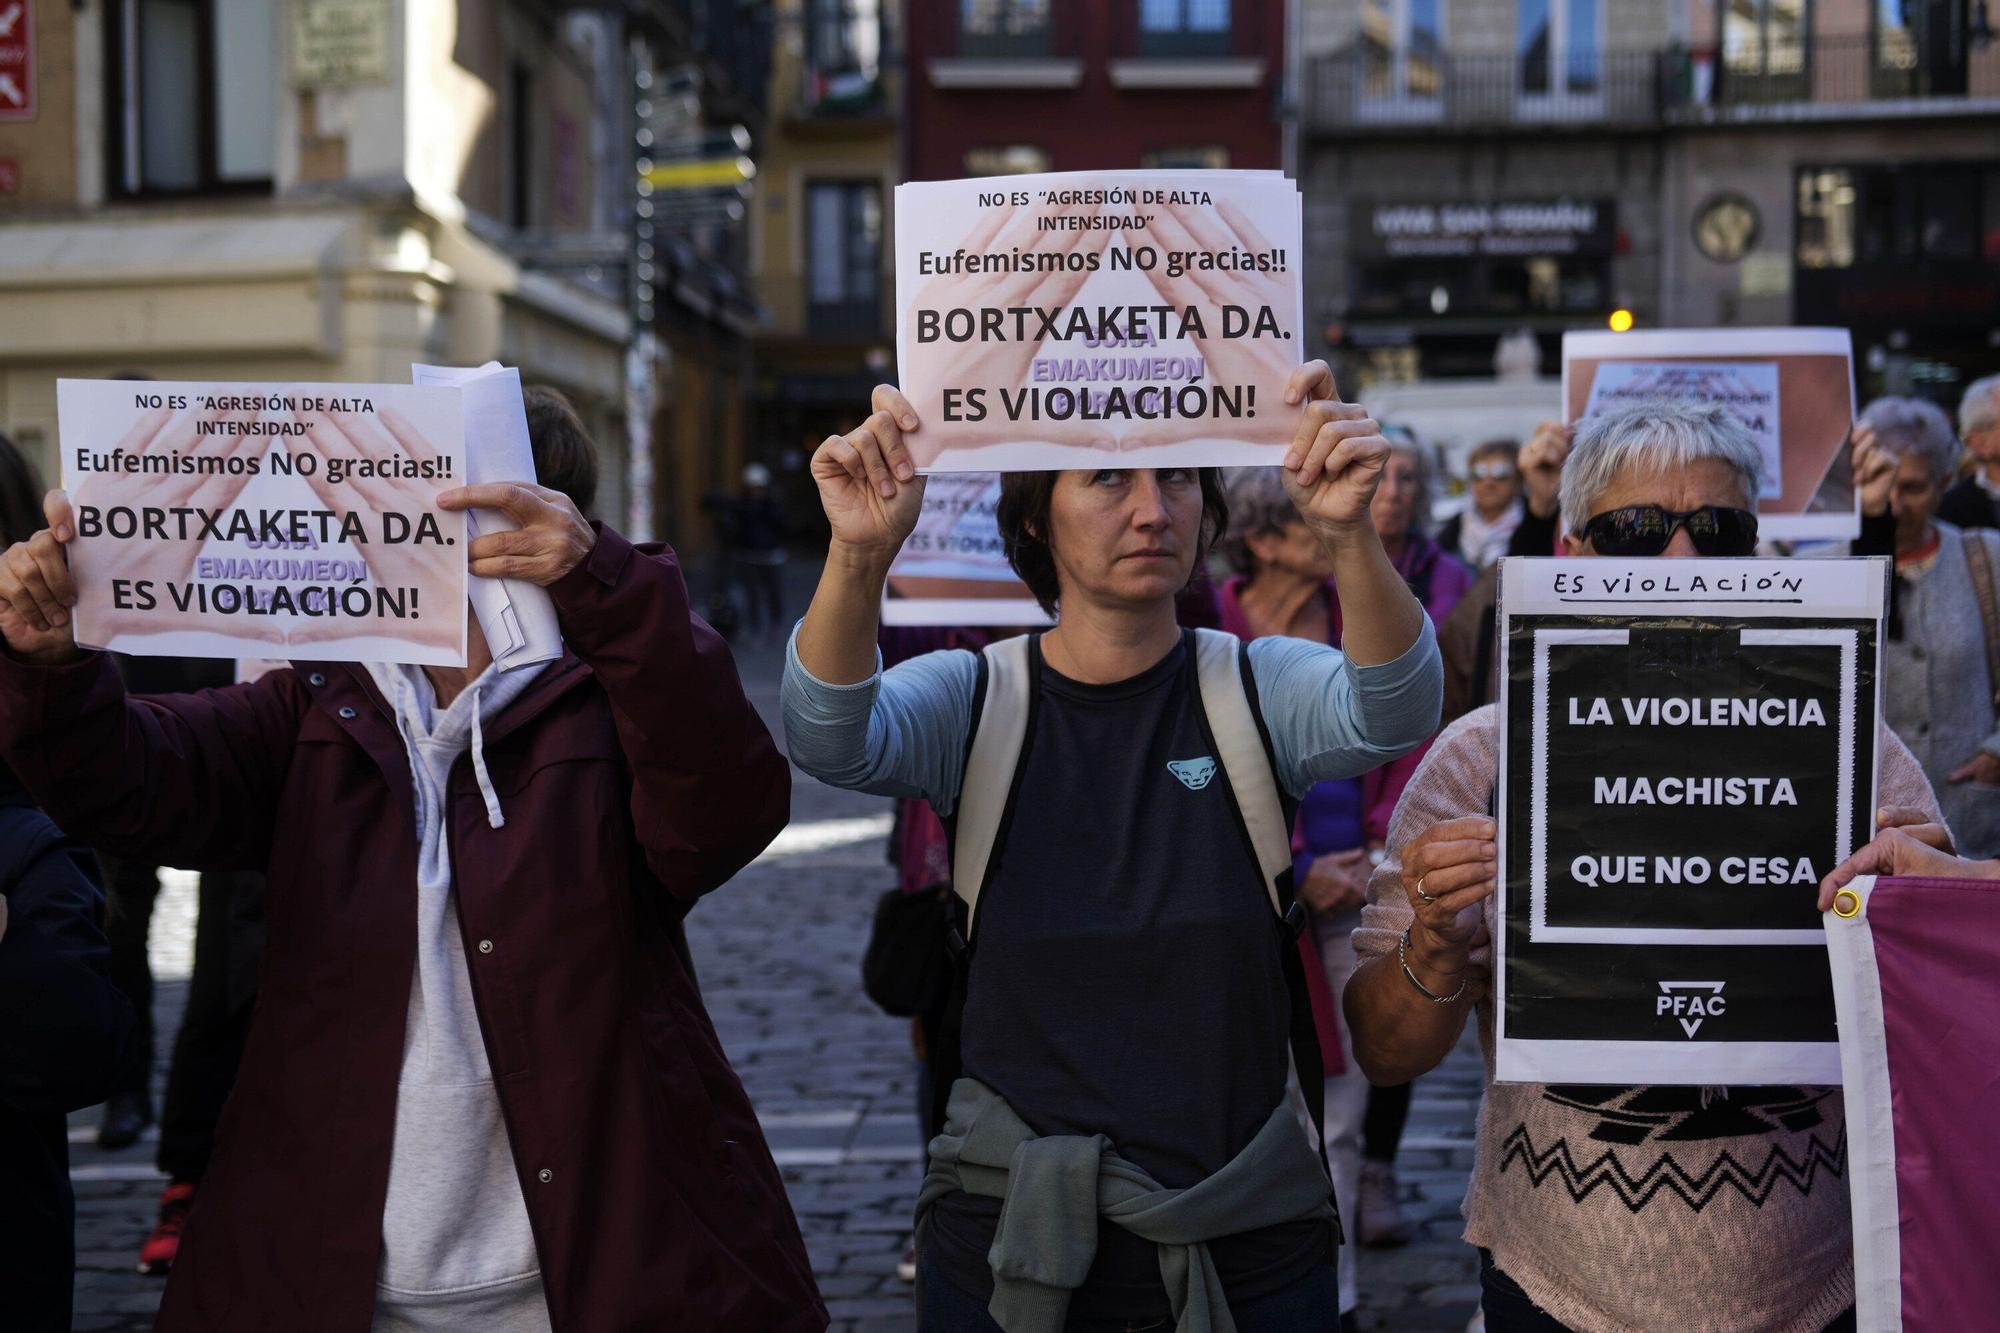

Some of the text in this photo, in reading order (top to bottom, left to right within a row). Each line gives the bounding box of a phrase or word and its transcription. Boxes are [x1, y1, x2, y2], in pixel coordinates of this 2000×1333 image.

[979, 193, 1006, 207] NO
[1011, 192, 1029, 206] ES
[1142, 190, 1164, 205] DE
[1168, 190, 1212, 206] ALTA
[919, 246, 1287, 279] Eufemismos NO gracias!!
[917, 305, 1292, 344] BORTXAKETA DA.
[1033, 356, 1206, 383] EMAKUMEON
[135, 394, 163, 410] NO
[168, 395, 187, 410] ES
[302, 397, 324, 412] DE
[329, 398, 374, 413] ALTA
[942, 376, 1256, 423] ES VIOLACIÓN!
[76, 448, 452, 484] Eufemismos NO gracias!!
[79, 505, 455, 547] BORTXAKETA DA.
[198, 556, 368, 583] EMAKUMEON
[1554, 573, 1585, 594] ES
[112, 578, 419, 620] ES VIOLACIÓN!
[1568, 697, 1827, 727] LA VIOLENCIA
[1594, 776, 1798, 806] MACHISTA
[1570, 855, 1818, 888] QUE NO CESA
[1657, 996, 1726, 1016] PFAC
